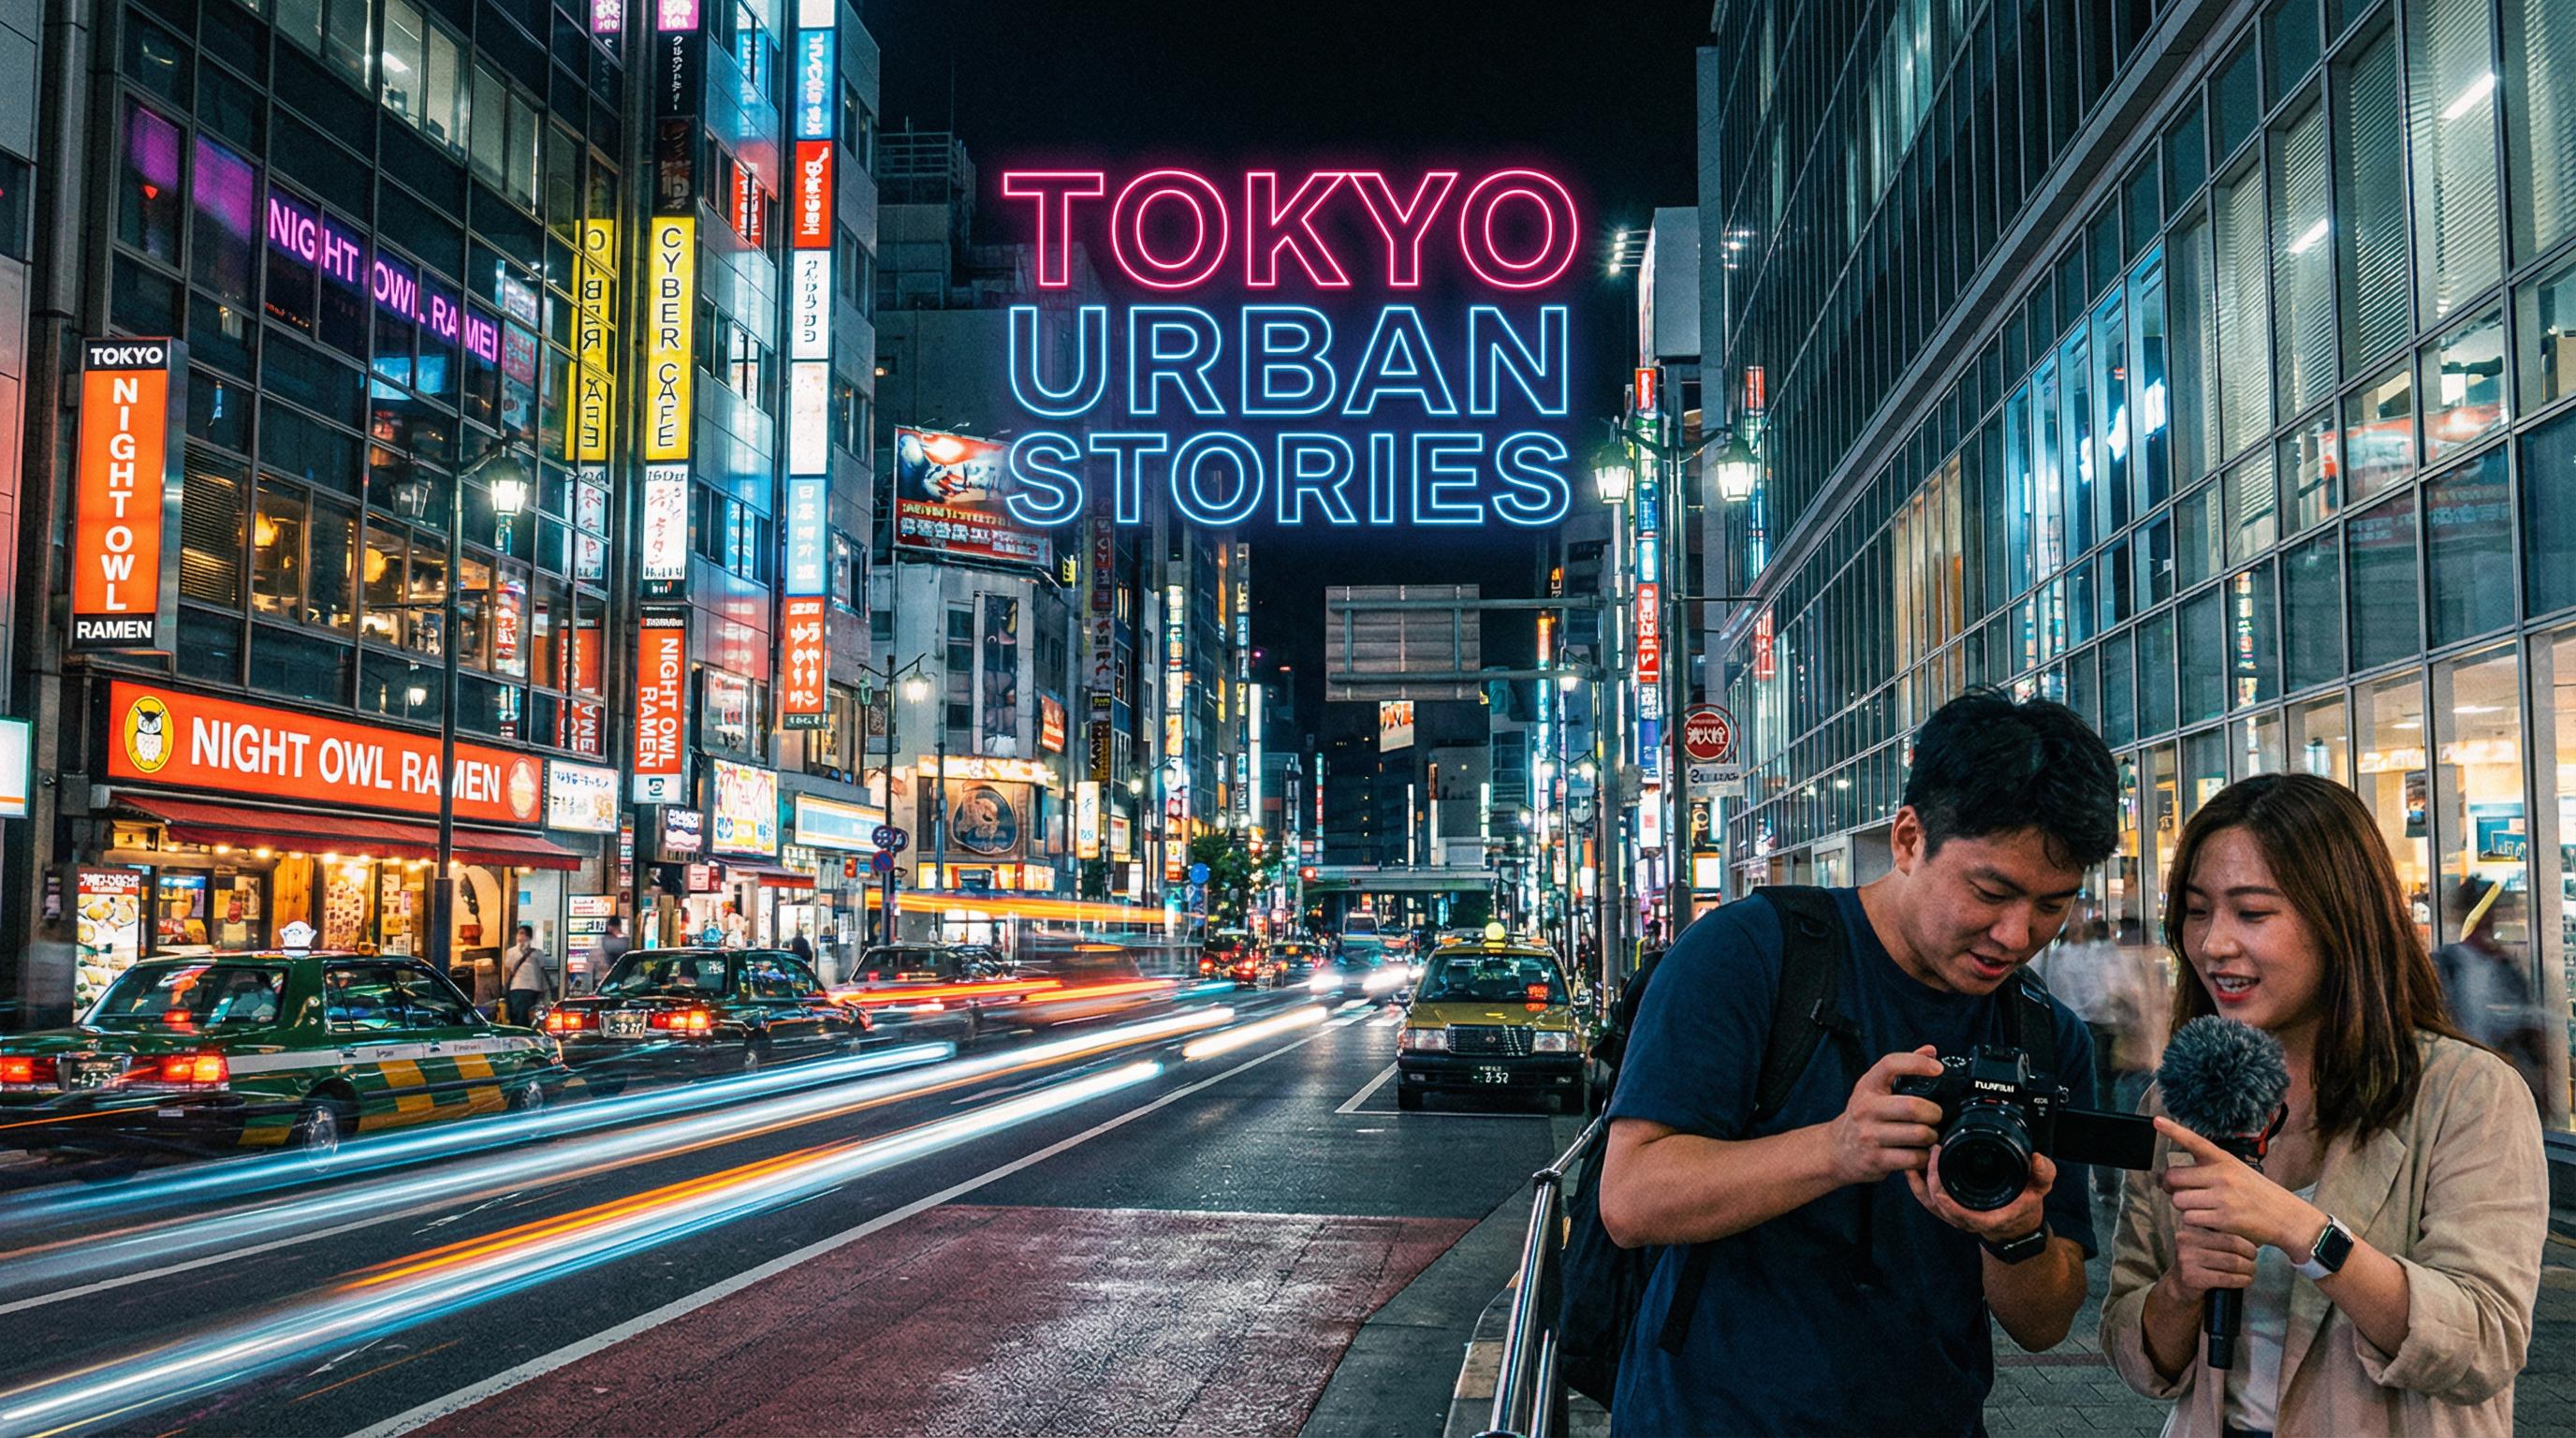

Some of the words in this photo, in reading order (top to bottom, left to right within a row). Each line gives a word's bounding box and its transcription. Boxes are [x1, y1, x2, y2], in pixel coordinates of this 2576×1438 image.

[269, 198, 359, 282] NIGHT
[374, 260, 426, 324] OWL
[661, 227, 681, 349] CYBER
[91, 345, 164, 367] TOKYO
[658, 362, 678, 447] CAFE
[110, 377, 138, 518] NIGHT
[101, 525, 135, 611] OWL
[77, 621, 154, 640] RAMEN
[658, 638, 679, 712] NIGHT
[192, 716, 311, 779] NIGHT
[318, 738, 393, 790] OWL
[638, 686, 658, 768] RAMEN
[658, 717, 677, 768] OWL
